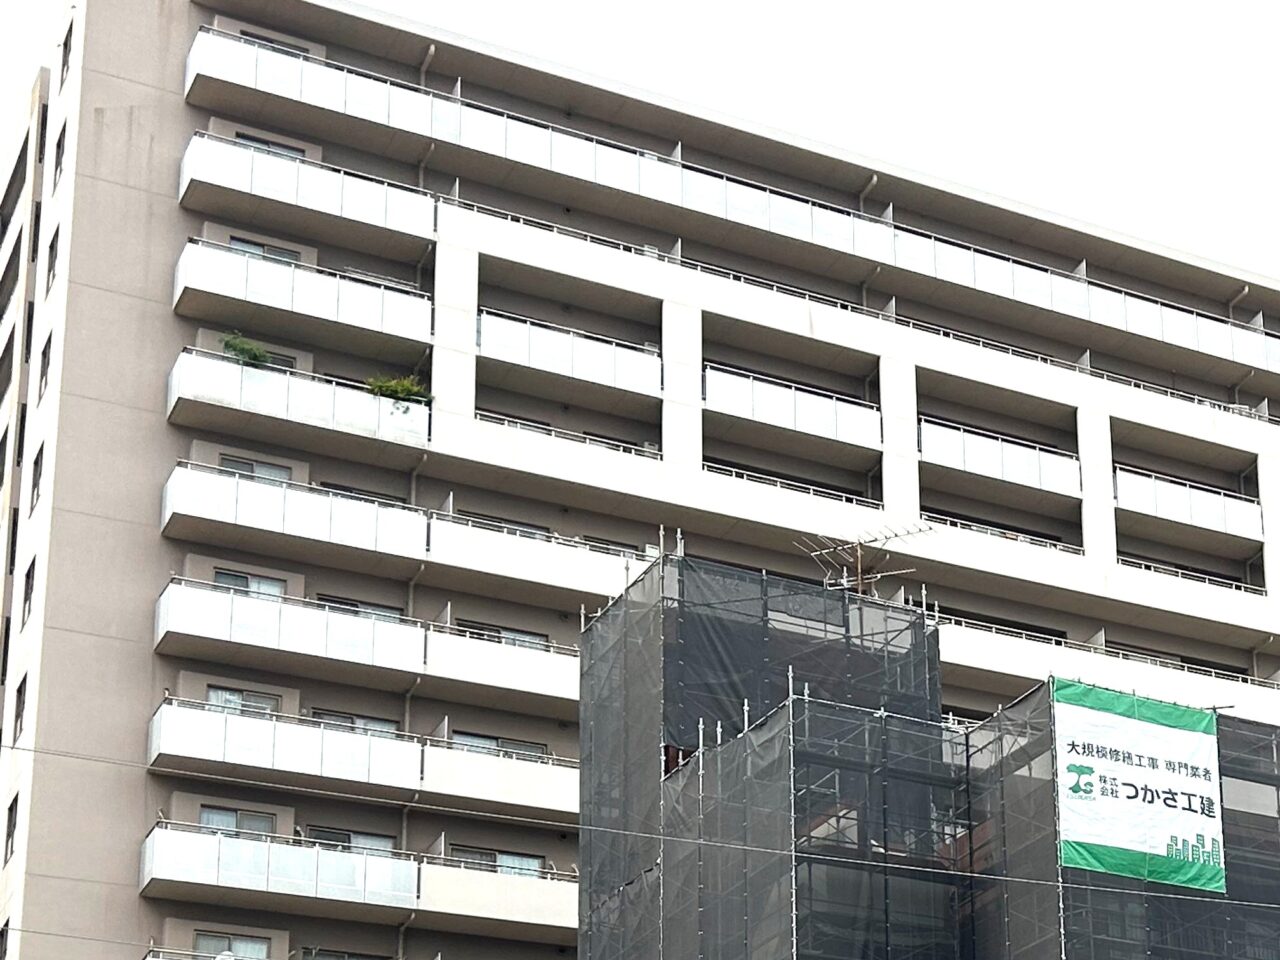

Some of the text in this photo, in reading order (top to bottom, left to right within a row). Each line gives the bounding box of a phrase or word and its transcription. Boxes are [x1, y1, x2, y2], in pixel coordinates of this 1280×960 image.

[1066, 740, 1212, 783] 大規模修繕工事 専門業者
[1121, 781, 1217, 819] つかさ工建
